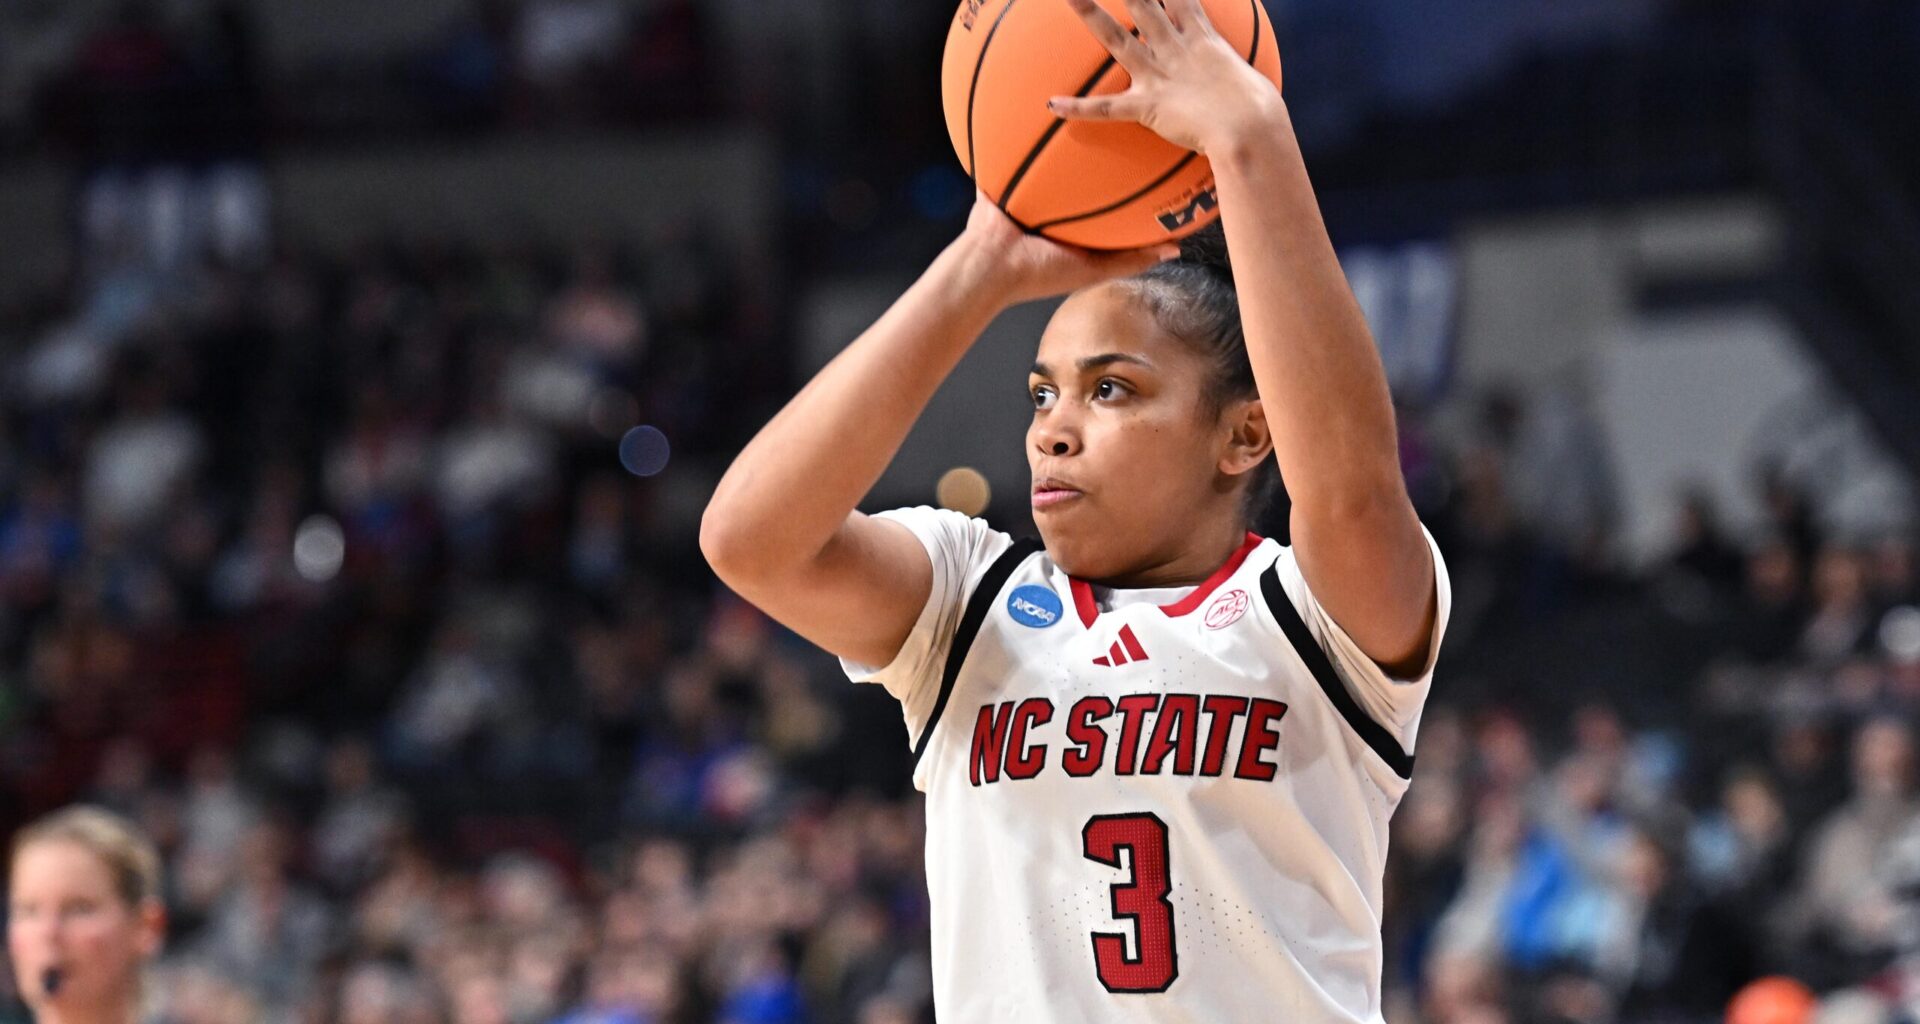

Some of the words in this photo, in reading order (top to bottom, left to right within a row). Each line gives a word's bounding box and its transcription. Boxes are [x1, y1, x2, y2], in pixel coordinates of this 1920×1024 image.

[1011, 597, 1056, 624] NCAA
[1209, 594, 1246, 620] ACC
[969, 697, 1055, 787] NC
[1061, 693, 1288, 782] STATE
[1081, 811, 1179, 994] 3
